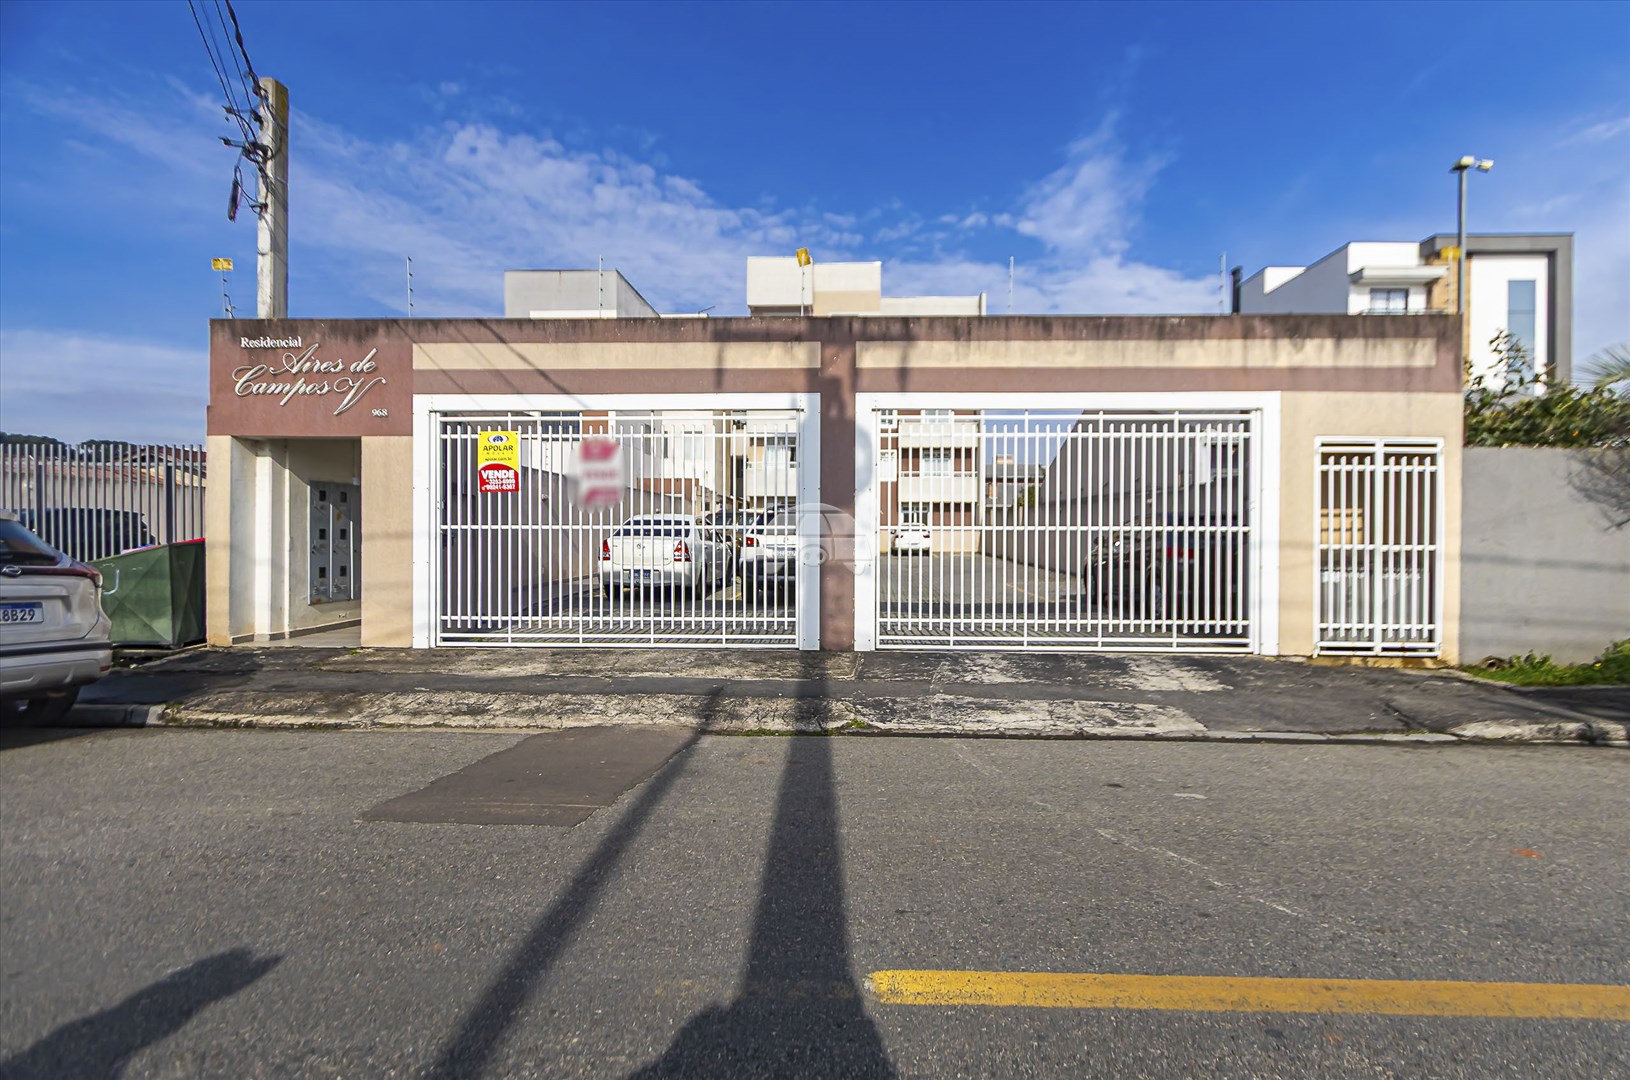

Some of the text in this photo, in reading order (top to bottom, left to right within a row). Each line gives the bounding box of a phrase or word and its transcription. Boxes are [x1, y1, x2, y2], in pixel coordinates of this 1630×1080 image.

[240, 336, 302, 348] Residencial
[269, 343, 377, 375] Aires de
[232, 364, 387, 416] Campos V
[371, 408, 388, 417] 968
[483, 444, 514, 452] APOLAR
[481, 469, 515, 479] VENDE
[0, 608, 35, 622] 8B29
